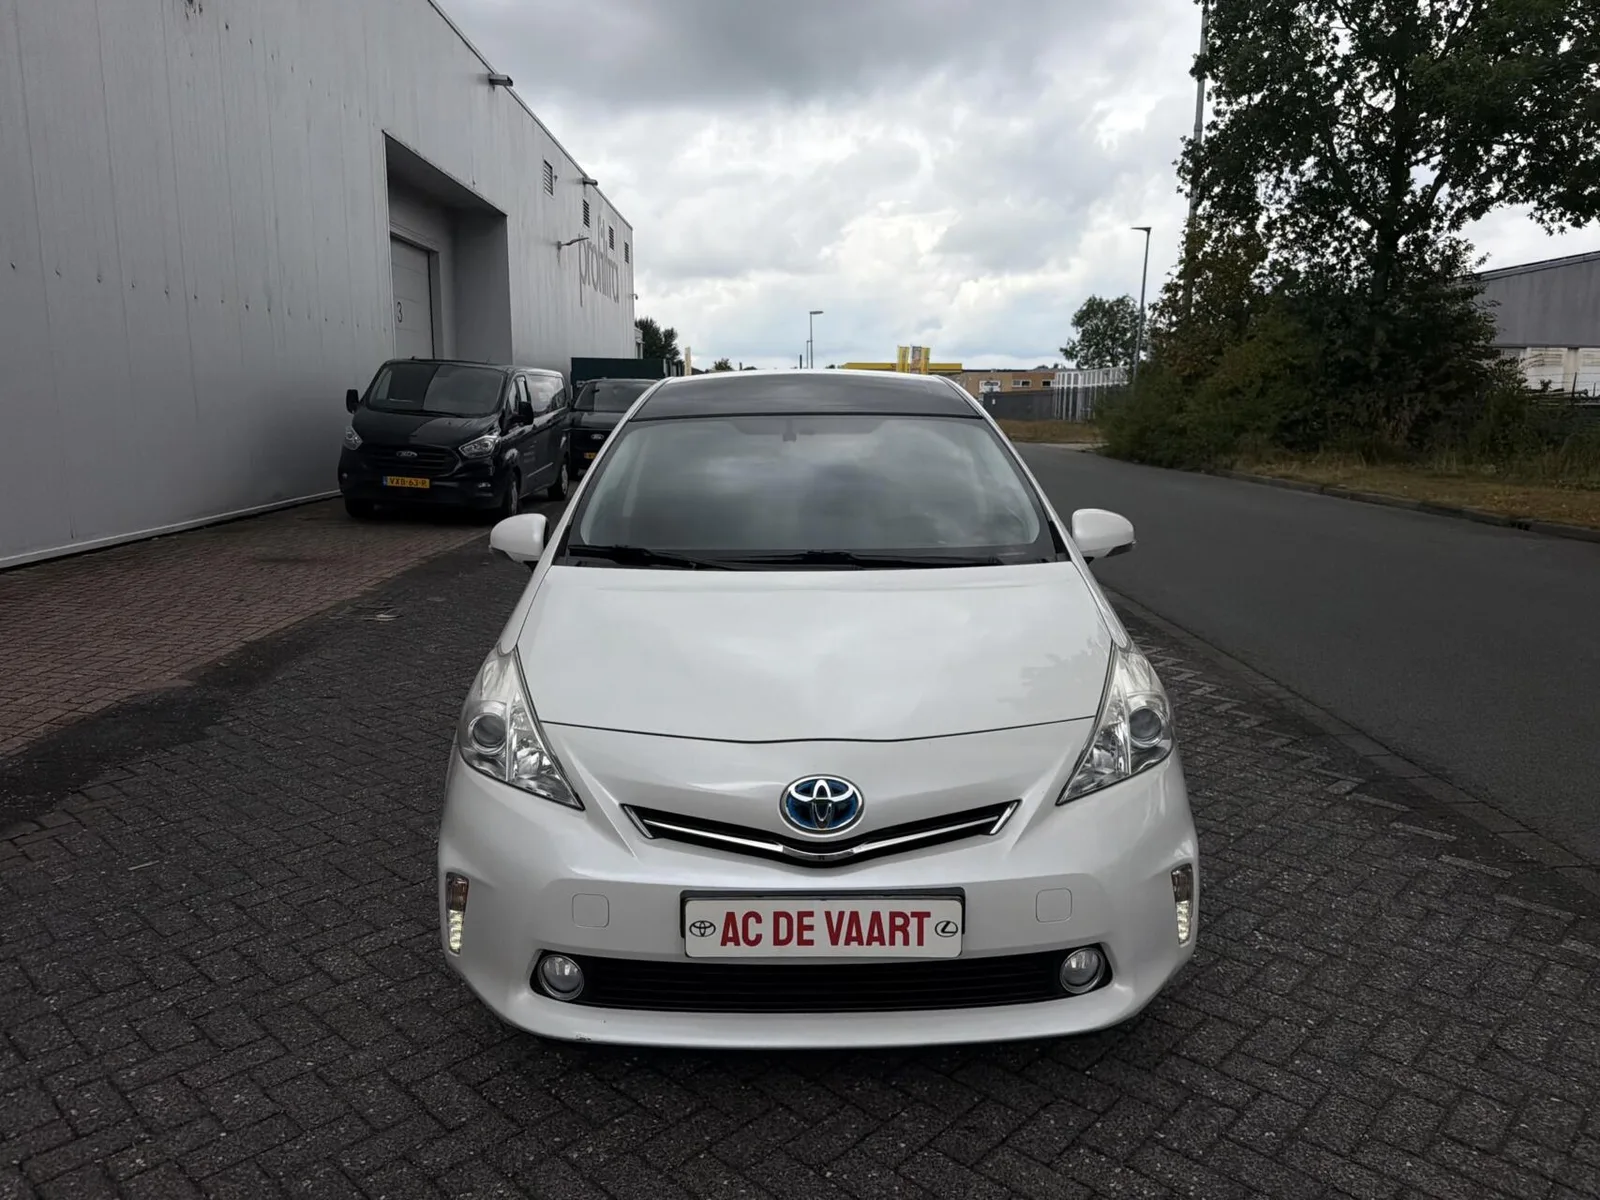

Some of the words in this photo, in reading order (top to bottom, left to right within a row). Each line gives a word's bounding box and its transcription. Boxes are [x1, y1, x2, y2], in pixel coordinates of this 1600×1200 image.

[397, 301, 403, 324] 3
[720, 911, 763, 947] AC
[772, 911, 815, 947] DE
[824, 911, 932, 947] VAART
